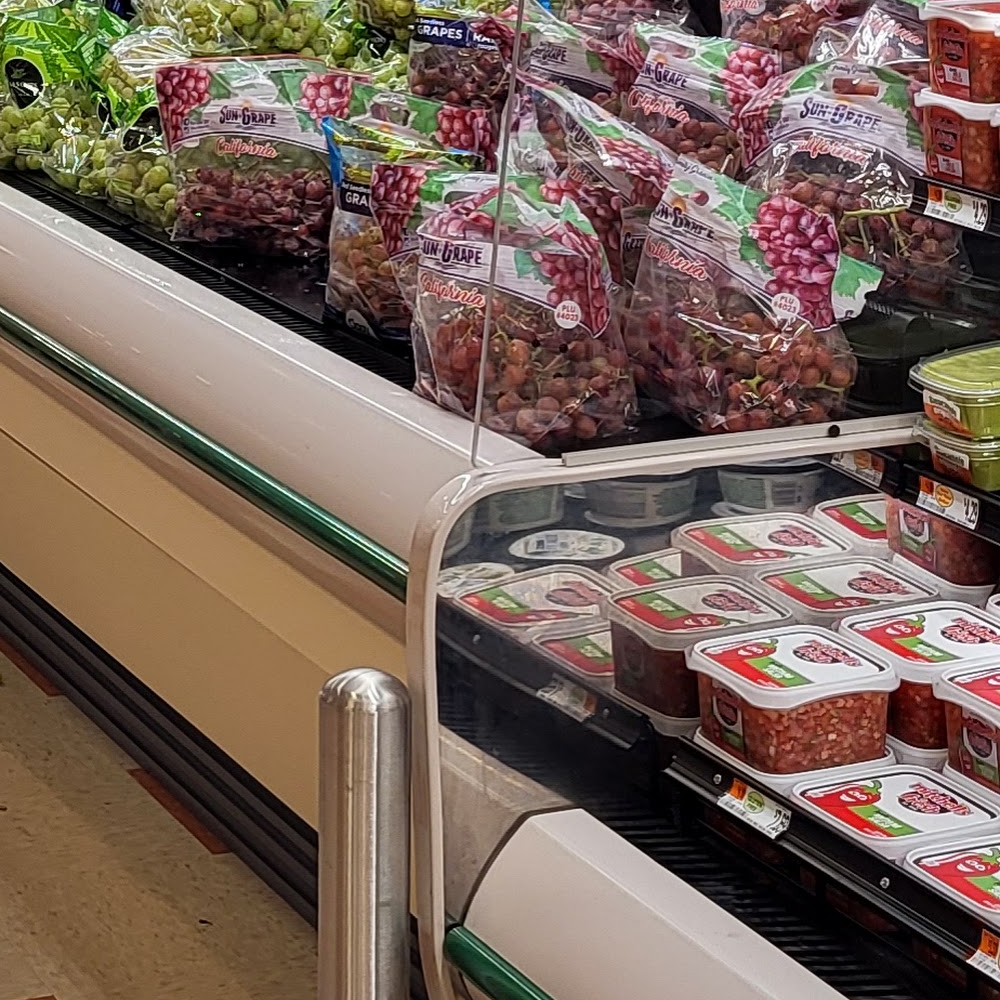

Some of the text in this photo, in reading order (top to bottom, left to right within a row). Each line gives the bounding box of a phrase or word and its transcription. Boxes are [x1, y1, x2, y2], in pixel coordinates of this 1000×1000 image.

[416, 25, 464, 40] GRAPES
[215, 135, 279, 159] California
[345, 191, 369, 207] GRA
[420, 271, 488, 308] California
[561, 303, 577, 314] PLU
